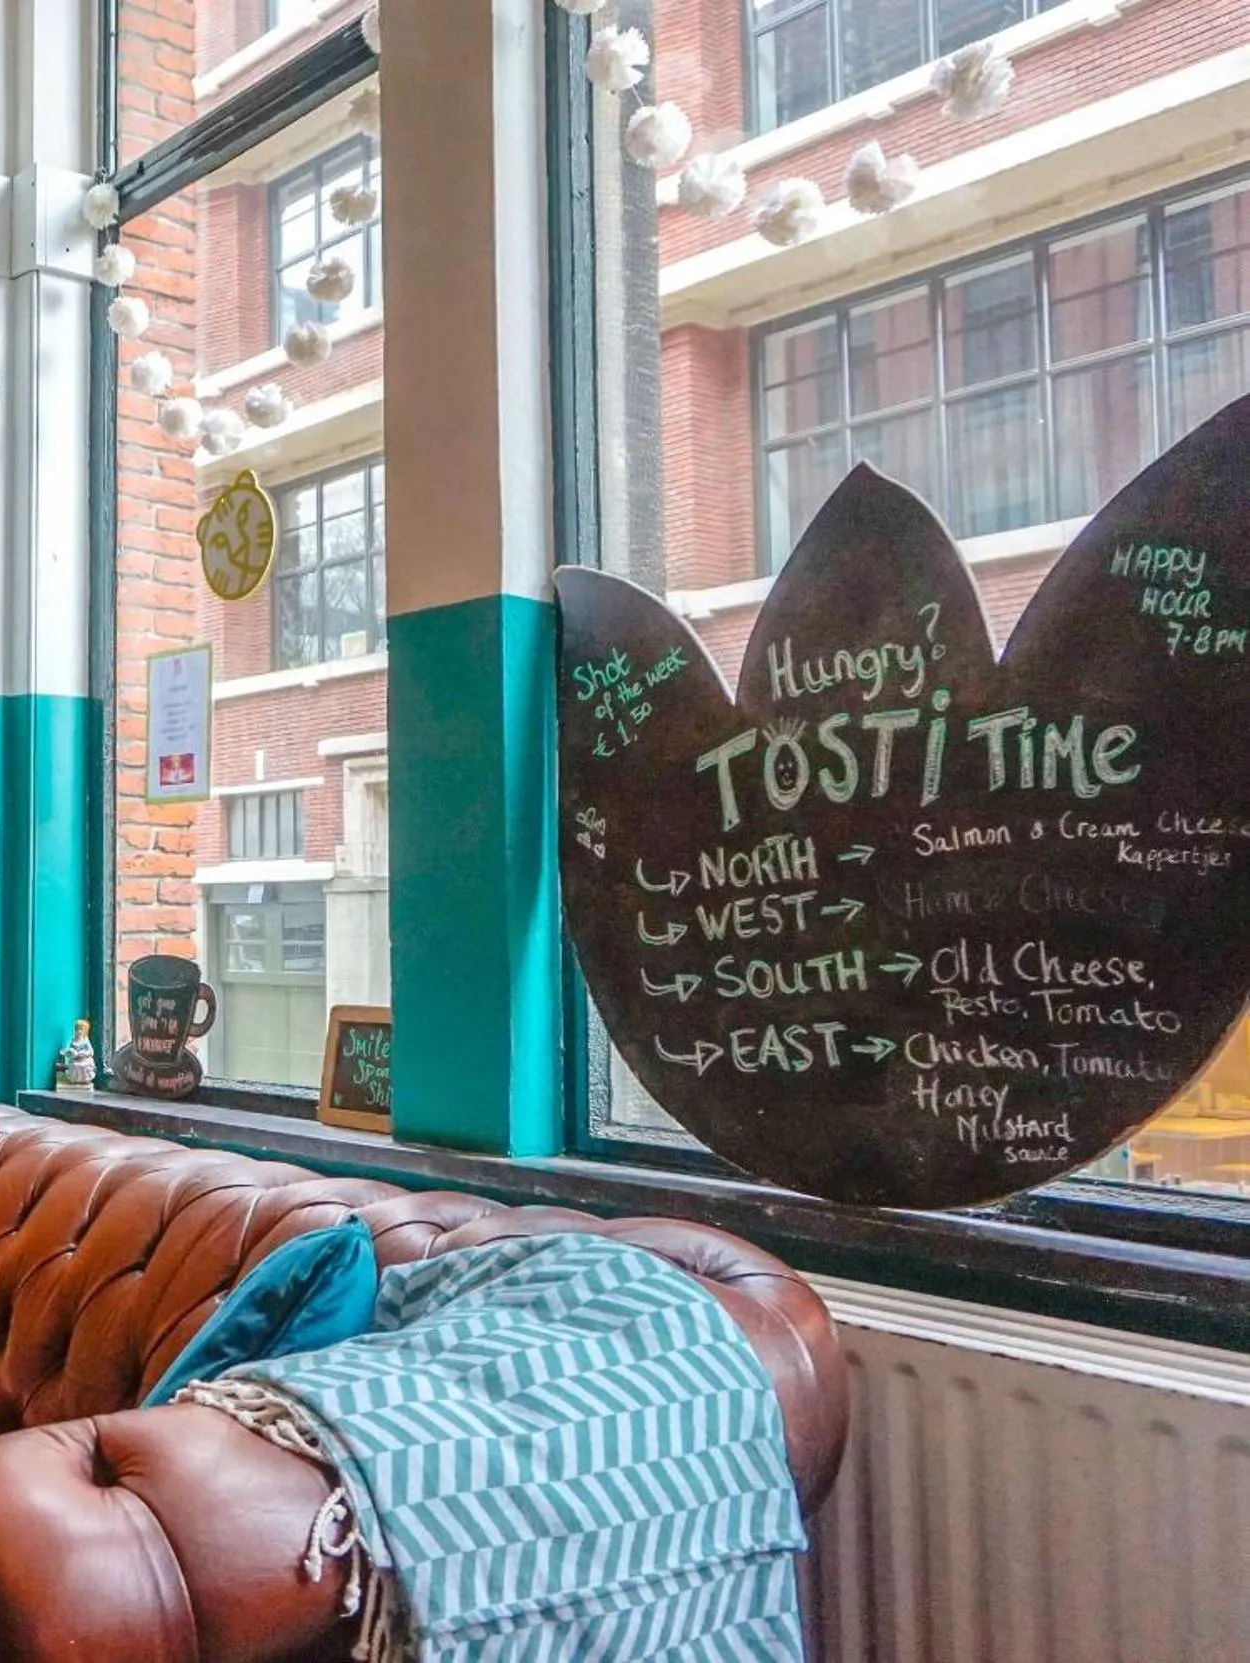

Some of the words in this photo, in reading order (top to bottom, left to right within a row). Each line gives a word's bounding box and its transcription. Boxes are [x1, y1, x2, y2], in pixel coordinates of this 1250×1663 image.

[1140, 586, 1212, 618] HOUR
[572, 647, 630, 700] Shot
[768, 602, 947, 701] Hungry?
[594, 691, 614, 720] of
[617, 681, 643, 704] the
[912, 823, 1012, 856] Salmon
[1059, 810, 1141, 840] Cream
[700, 833, 819, 890] NORTH
[696, 890, 819, 941] WEST
[714, 950, 868, 999] SOUTH
[930, 937, 1002, 986] Old
[1029, 988, 1182, 1034] Tomato
[343, 1027, 391, 1061] Smile
[729, 1020, 848, 1073] EAST
[911, 1074, 1010, 1119] Honey
